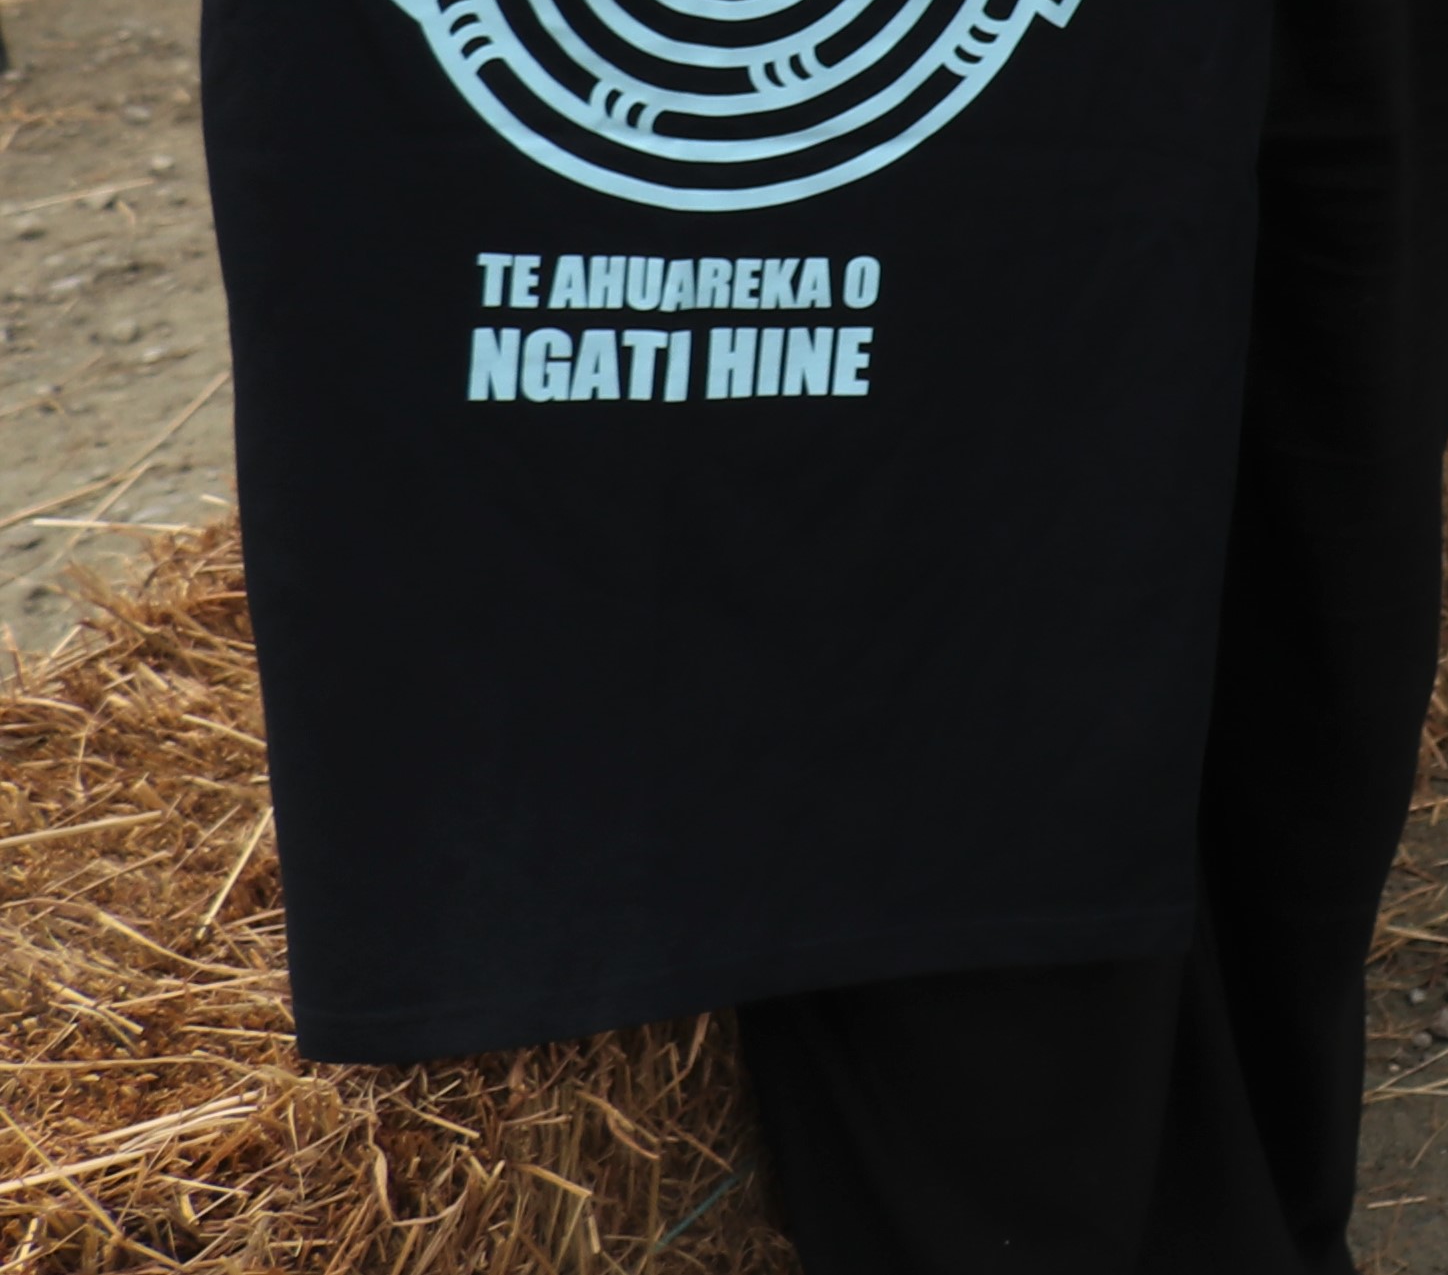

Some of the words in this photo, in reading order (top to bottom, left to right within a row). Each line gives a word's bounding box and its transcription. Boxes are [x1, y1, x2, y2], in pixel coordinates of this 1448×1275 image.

[477, 253, 541, 307] TE
[547, 255, 832, 312] AHUAREKA
[843, 256, 881, 308] O
[467, 328, 692, 402] NGATI
[705, 327, 874, 400] HINE
